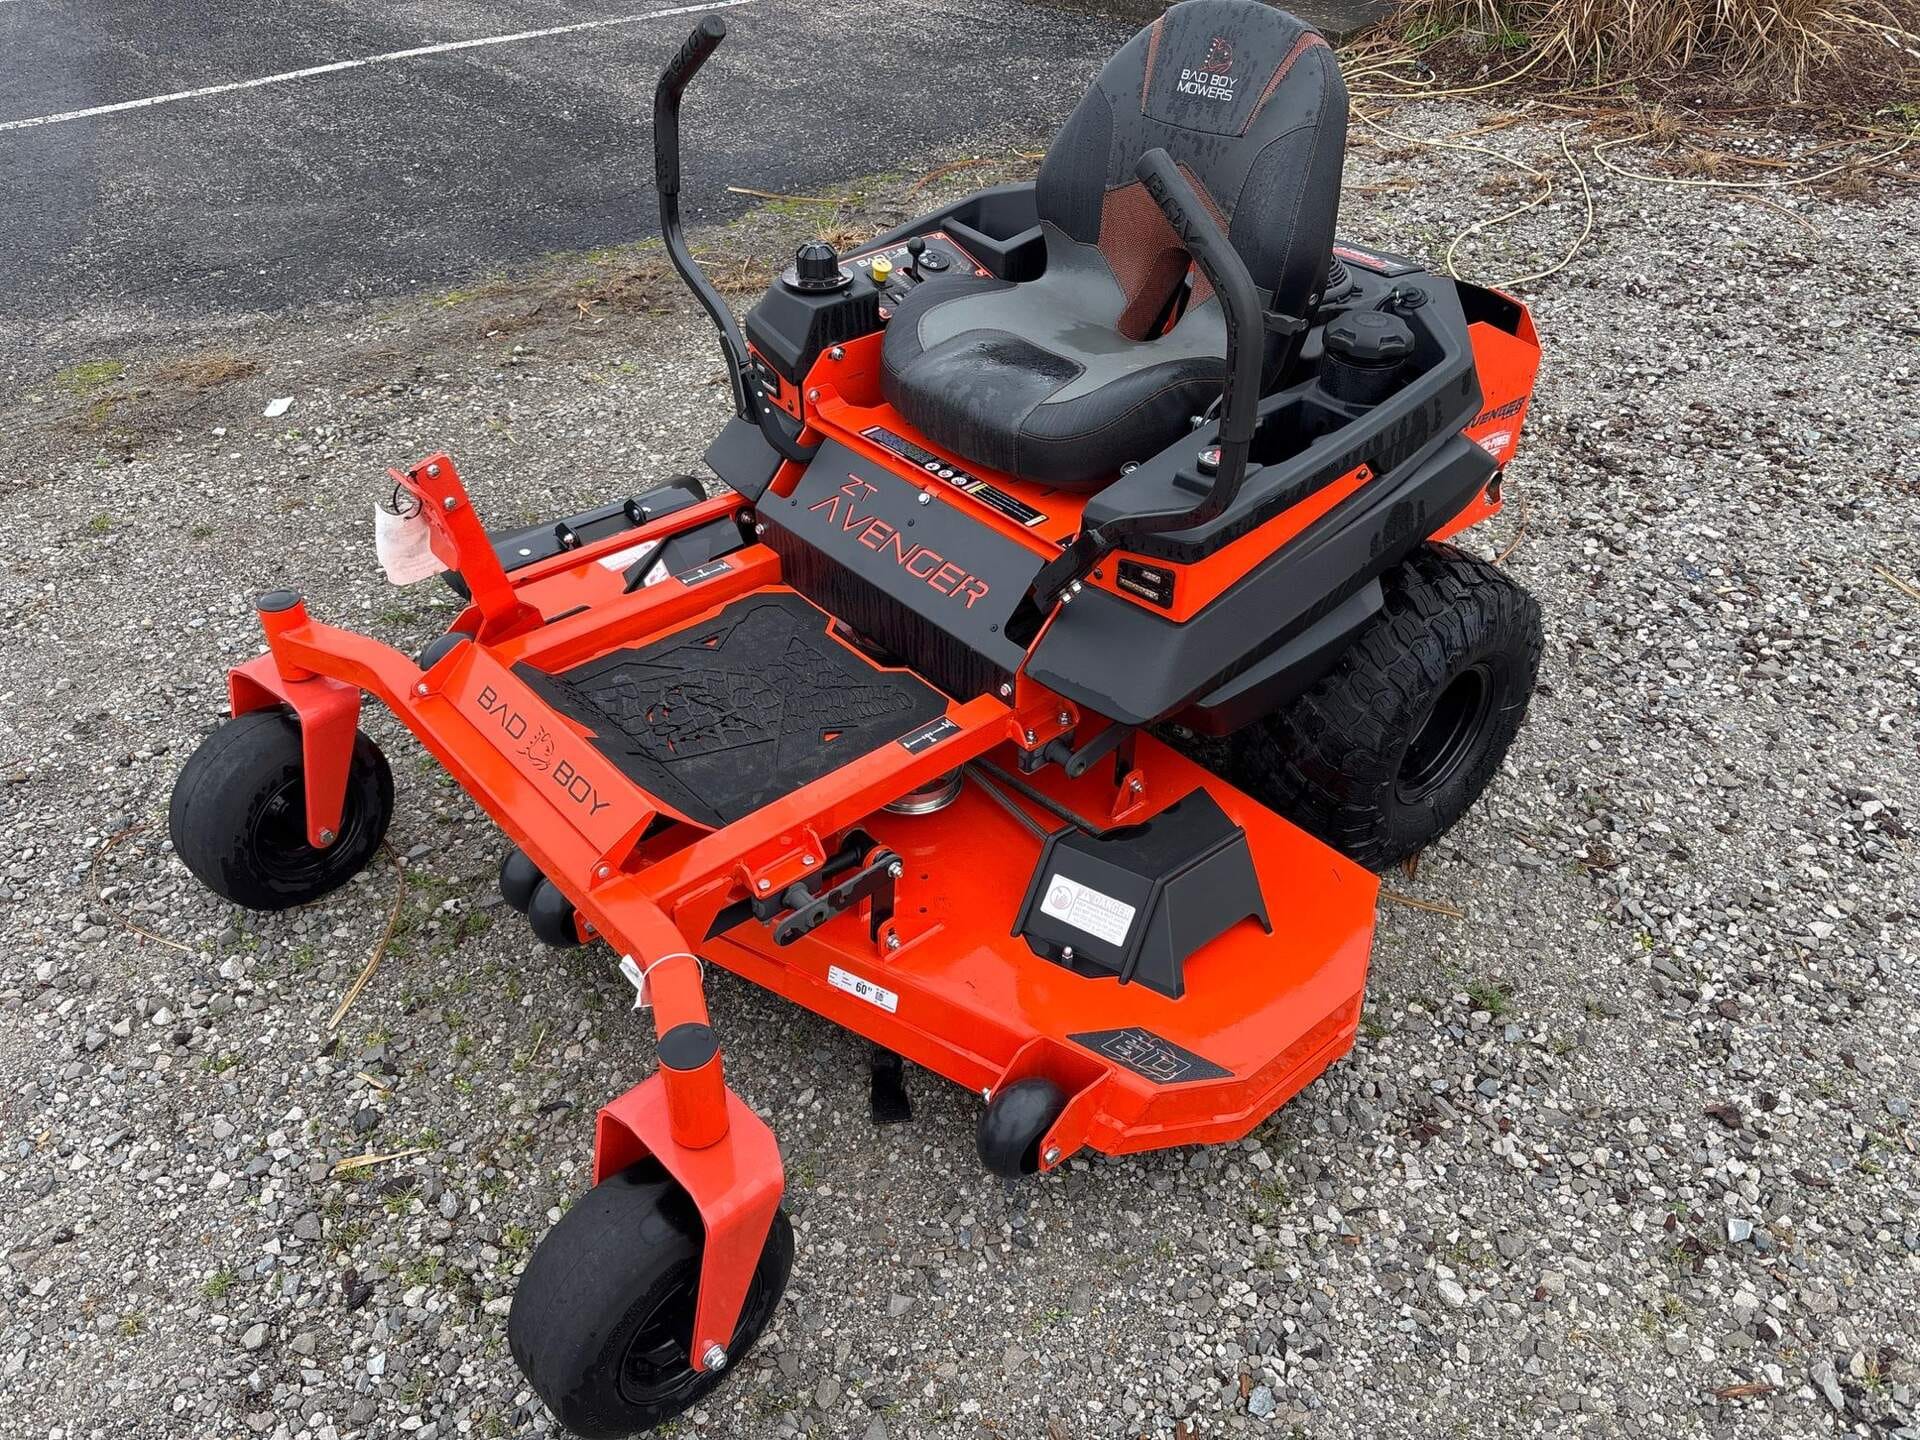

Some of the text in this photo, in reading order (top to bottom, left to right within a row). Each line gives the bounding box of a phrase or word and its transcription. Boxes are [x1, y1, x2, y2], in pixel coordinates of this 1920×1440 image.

[1176, 80, 1234, 102] MOWERS
[1181, 69, 1239, 89] BAD BOY
[839, 472, 879, 502] ZT
[807, 495, 991, 609] AVENGER
[476, 685, 611, 816] BAD BOY
